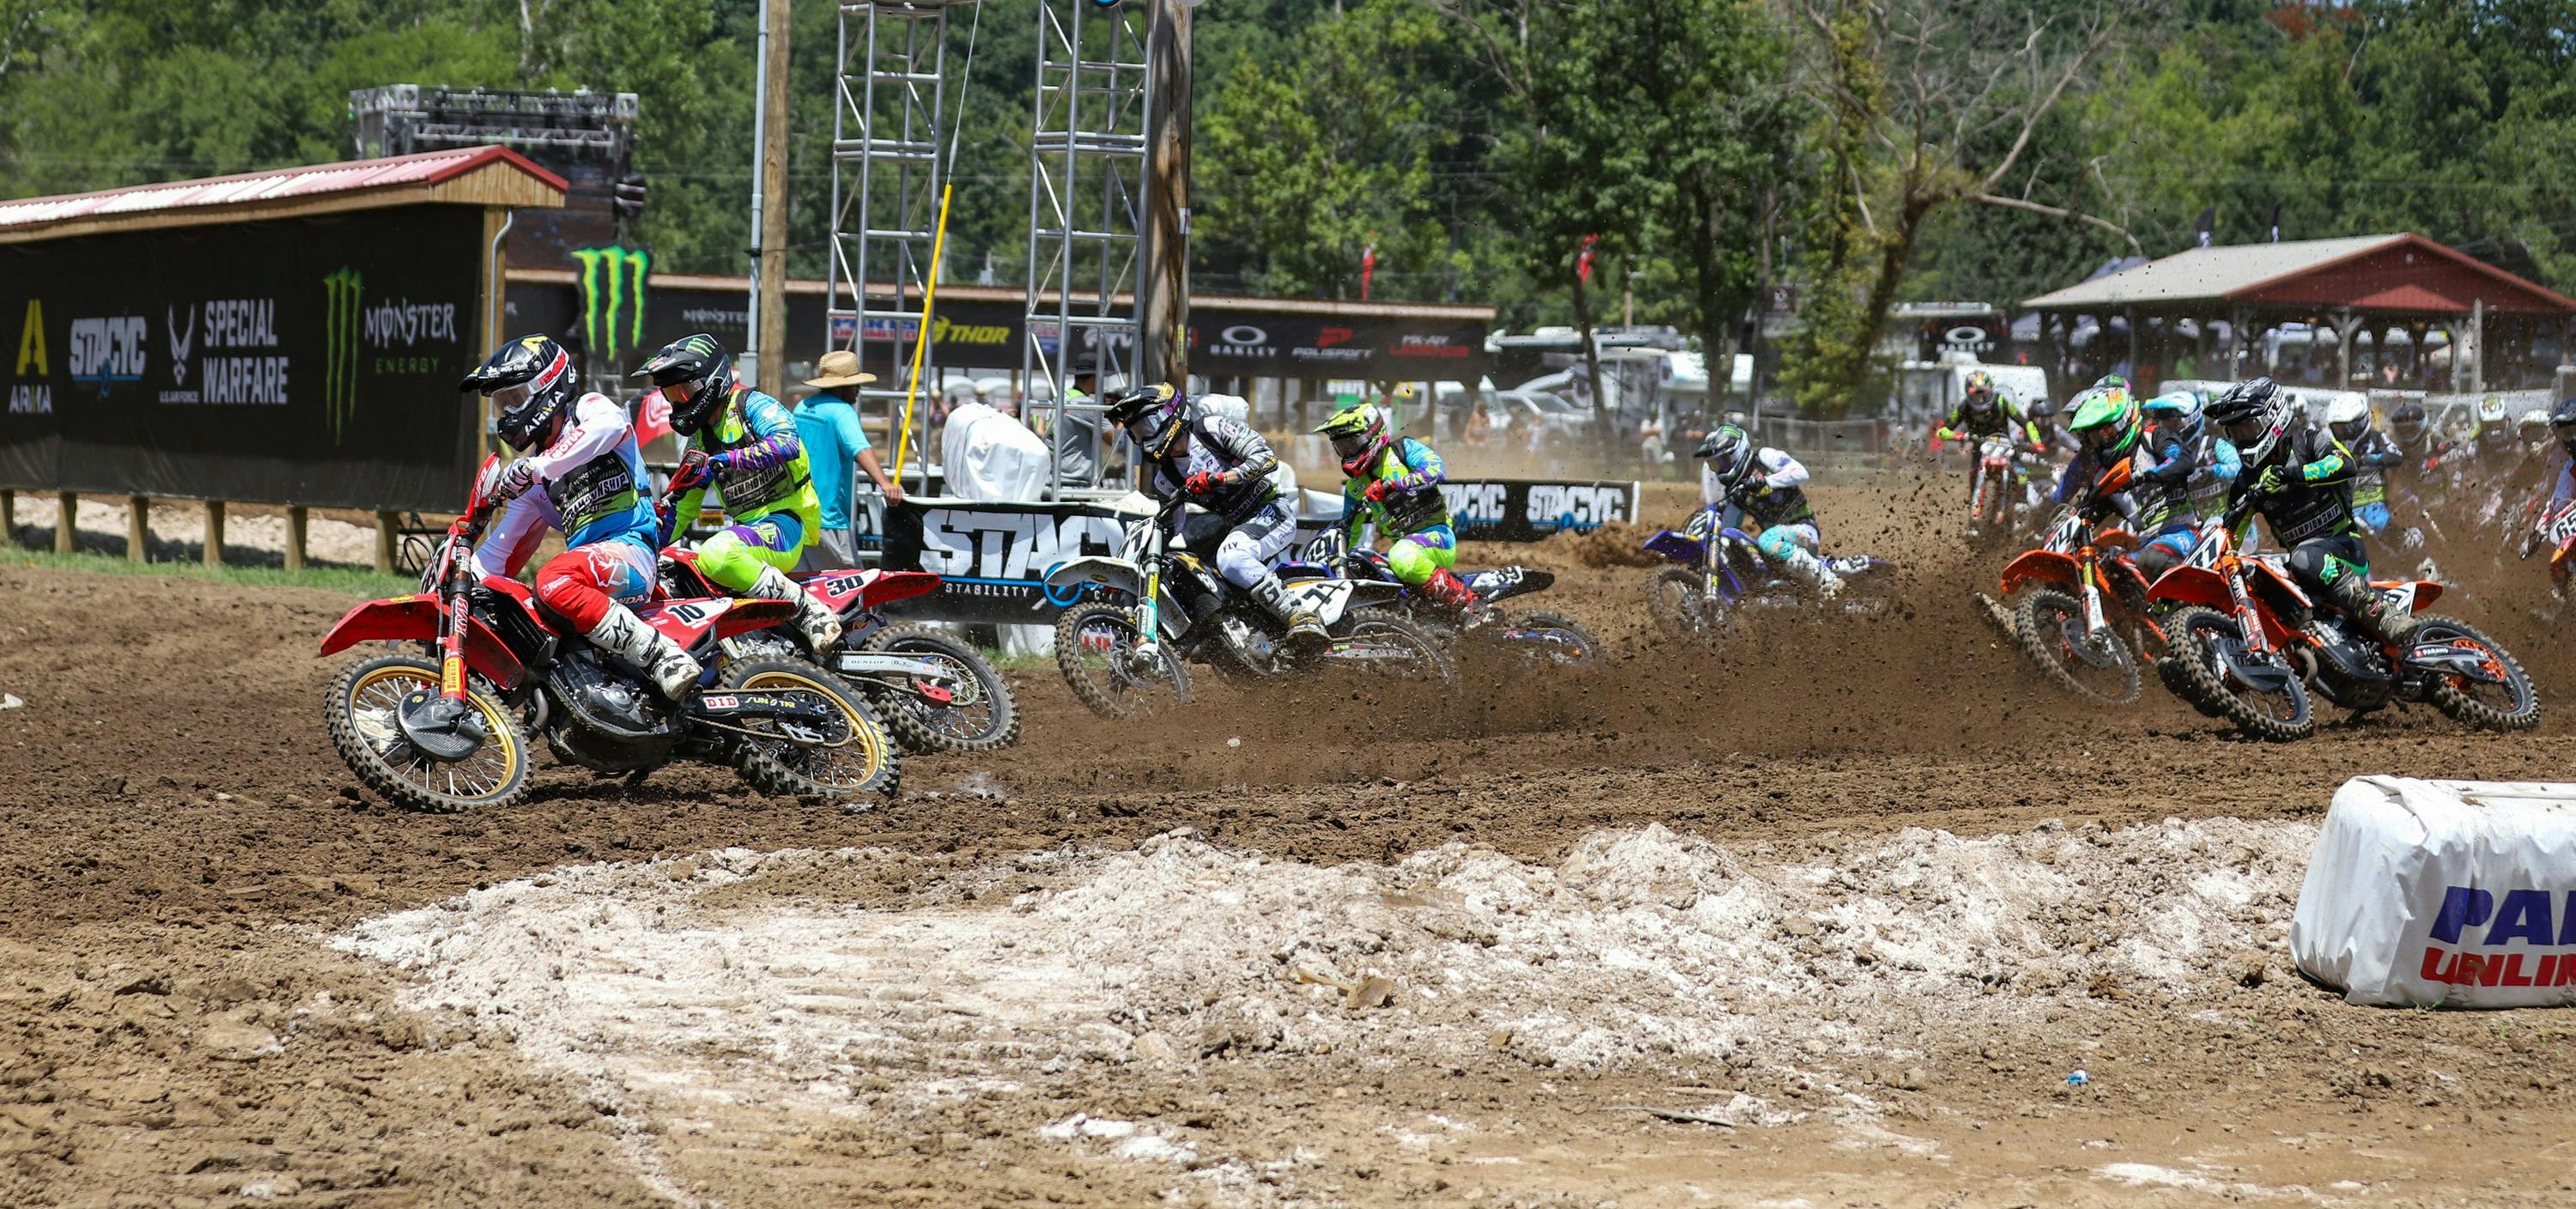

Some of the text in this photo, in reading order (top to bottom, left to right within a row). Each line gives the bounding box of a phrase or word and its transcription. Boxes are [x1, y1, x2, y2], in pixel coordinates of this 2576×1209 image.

[204, 299, 278, 347] SPECIAL
[365, 297, 457, 348] MONSTER
[682, 307, 750, 321] MONSTE
[70, 316, 147, 376] STACYC
[949, 325, 1011, 343] THOR
[1210, 345, 1279, 357] OAKLEY
[204, 355, 289, 404] WARFARE
[375, 357, 440, 374] ENERGY
[9, 385, 52, 413] ARMA
[550, 428, 585, 459] MOTUL
[1439, 483, 1507, 519] TACYC
[1526, 485, 1625, 523] STACYC
[1223, 541, 1238, 554] FLY
[617, 594, 644, 604] NDA
[826, 575, 865, 596] 30
[945, 583, 1030, 598] STABILITY
[667, 604, 706, 623] 10
[444, 659, 458, 690] PIRELLI
[705, 697, 738, 708] DID
[868, 720, 889, 771] PIRELLI
[2429, 886, 2576, 945] PA
